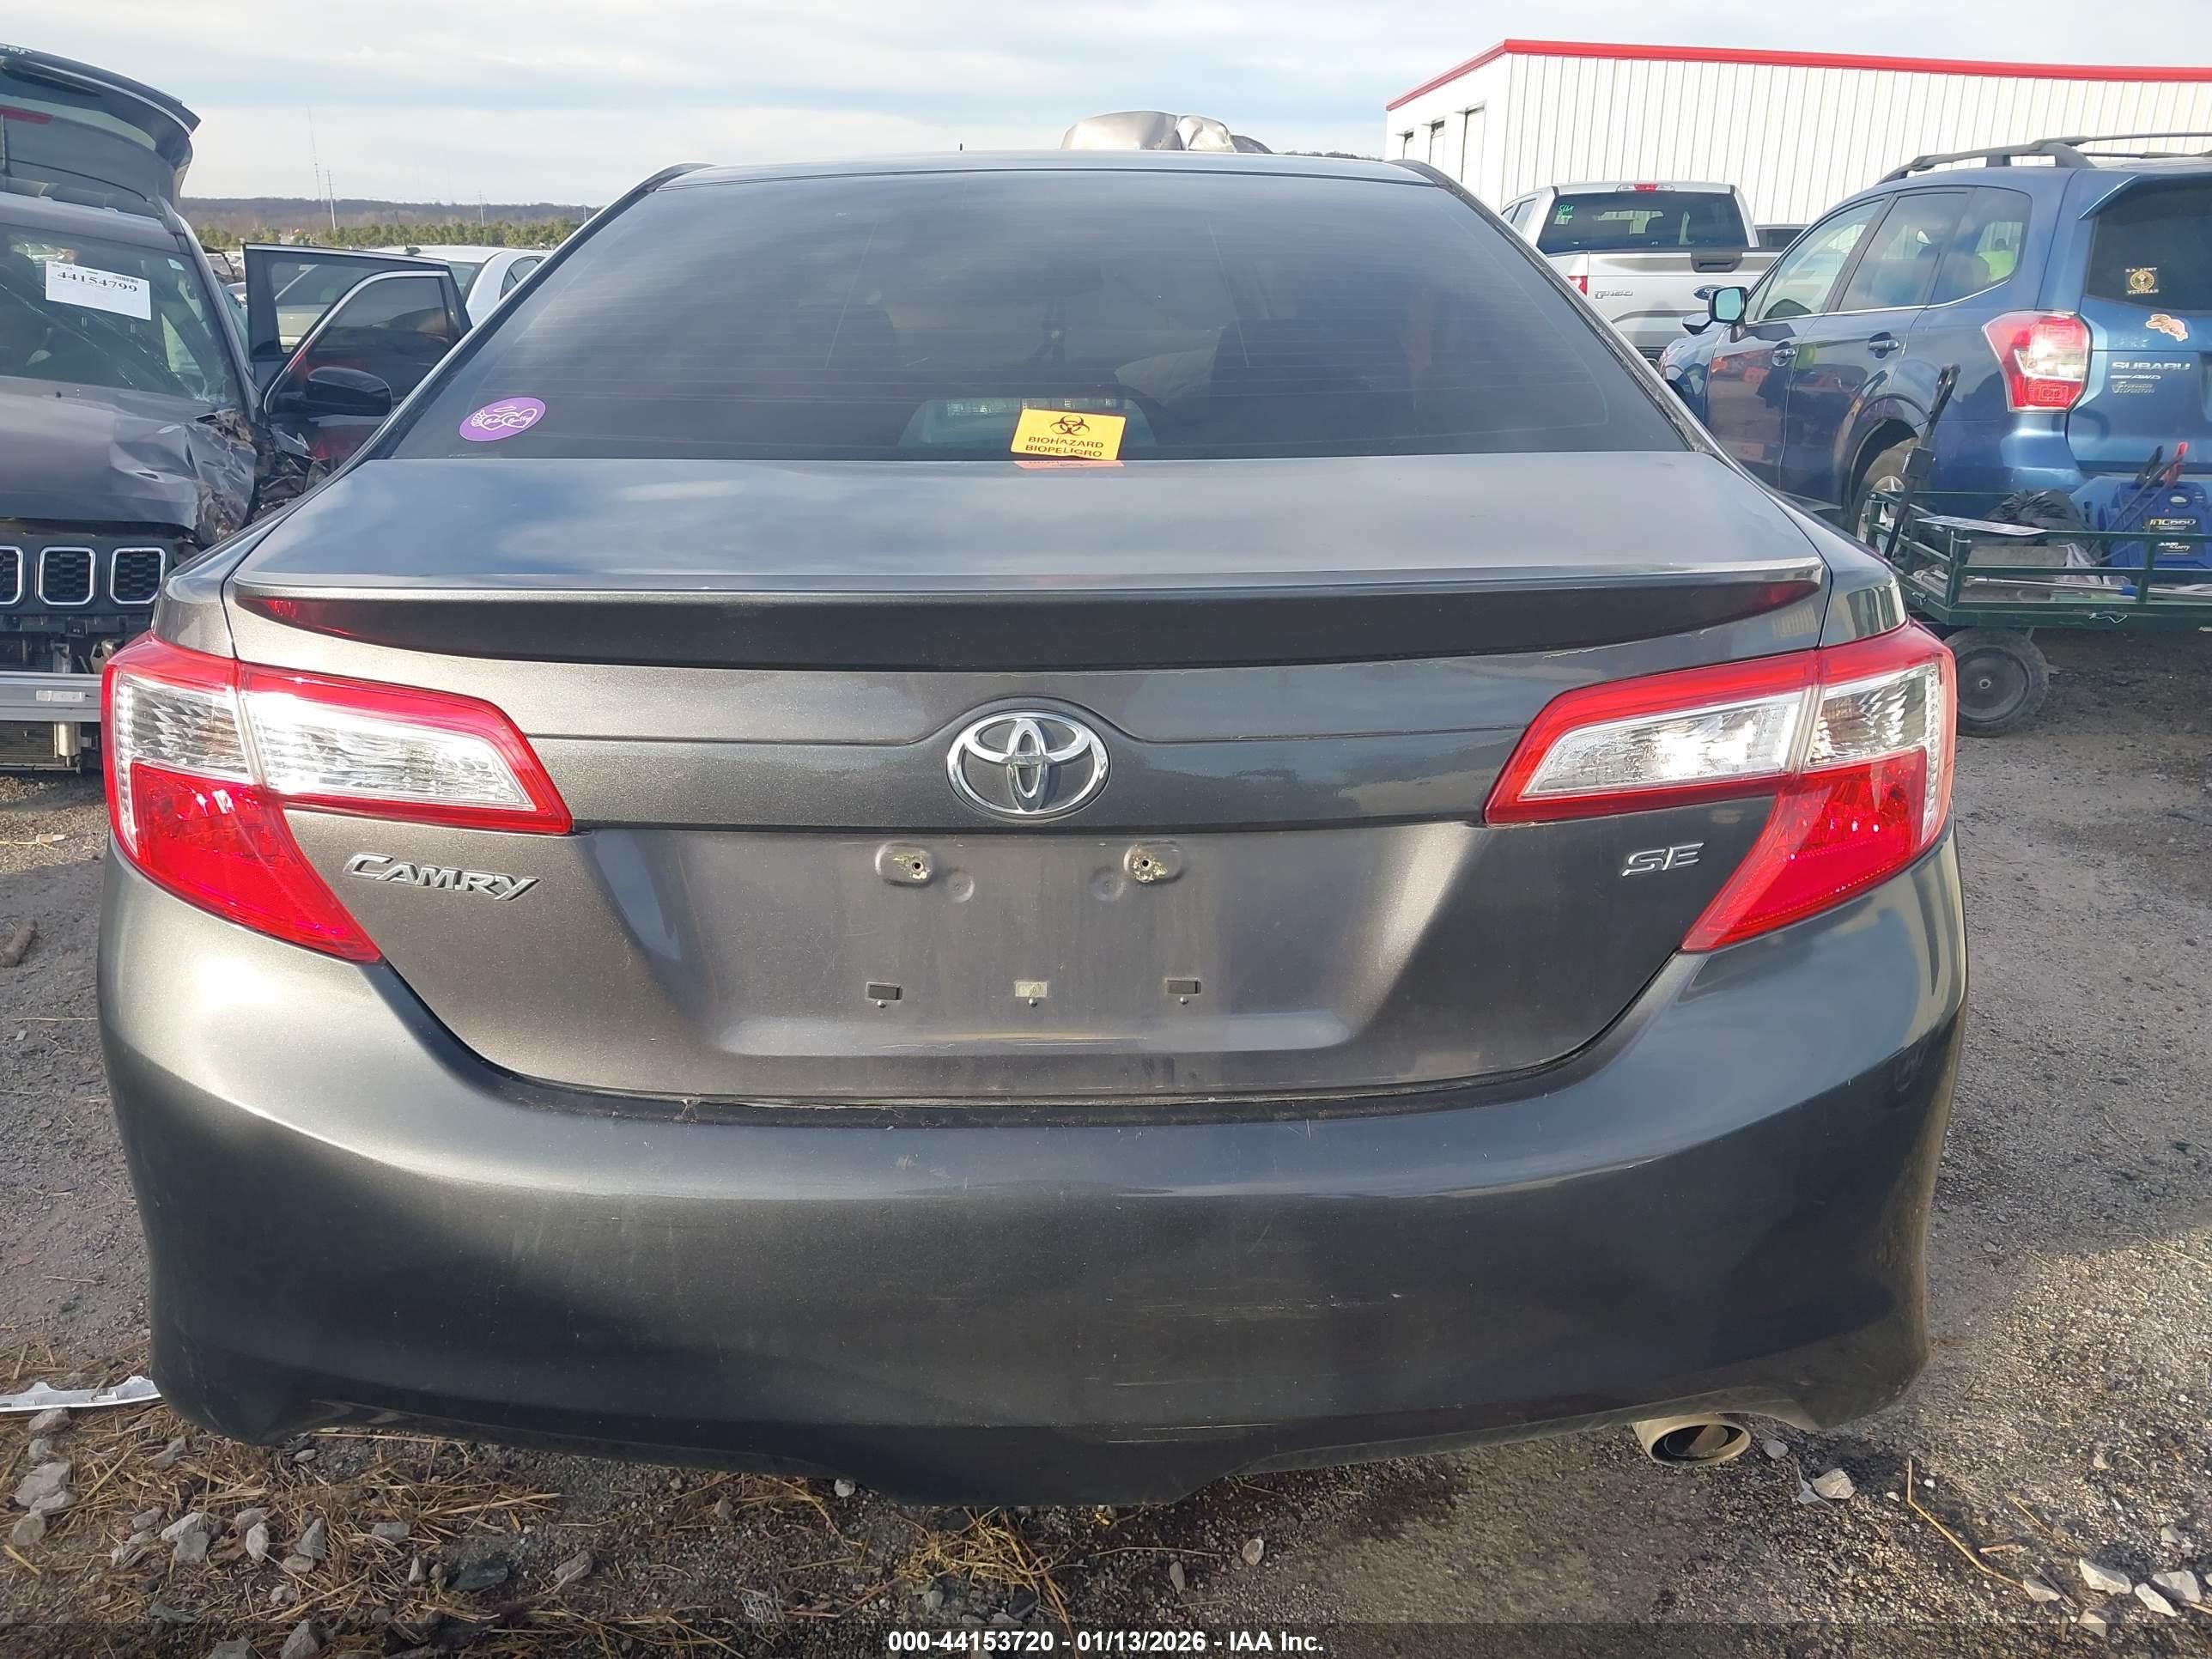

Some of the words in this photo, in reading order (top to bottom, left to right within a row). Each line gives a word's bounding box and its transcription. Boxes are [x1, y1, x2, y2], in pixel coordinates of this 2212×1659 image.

[57, 271, 138, 293] 44154799
[2112, 362, 2191, 371] SUBARU
[1025, 444, 1103, 458] BIOPELIGRO
[1028, 436, 1104, 448] BIOHAZARD
[1621, 842, 1705, 877] SE
[343, 851, 541, 901] CAMRY
